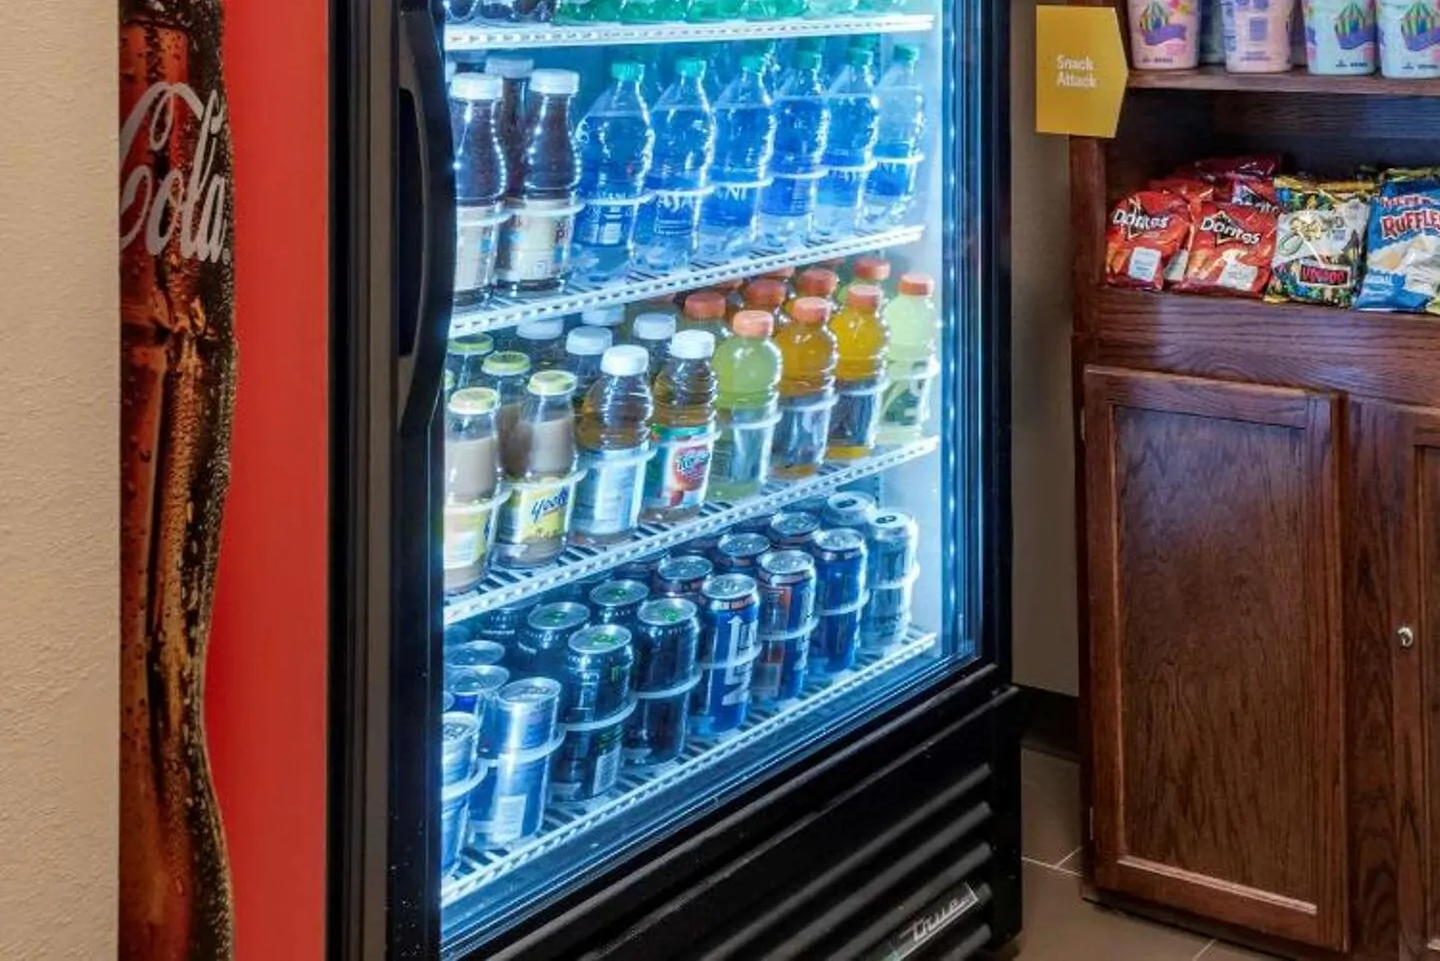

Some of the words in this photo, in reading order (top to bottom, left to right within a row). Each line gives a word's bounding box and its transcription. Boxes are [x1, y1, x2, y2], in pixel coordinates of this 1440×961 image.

[1056, 56, 1094, 71] Snack
[1056, 72, 1097, 88] Attack
[1112, 209, 1170, 229] Doritos
[1200, 218, 1261, 245] Doritos
